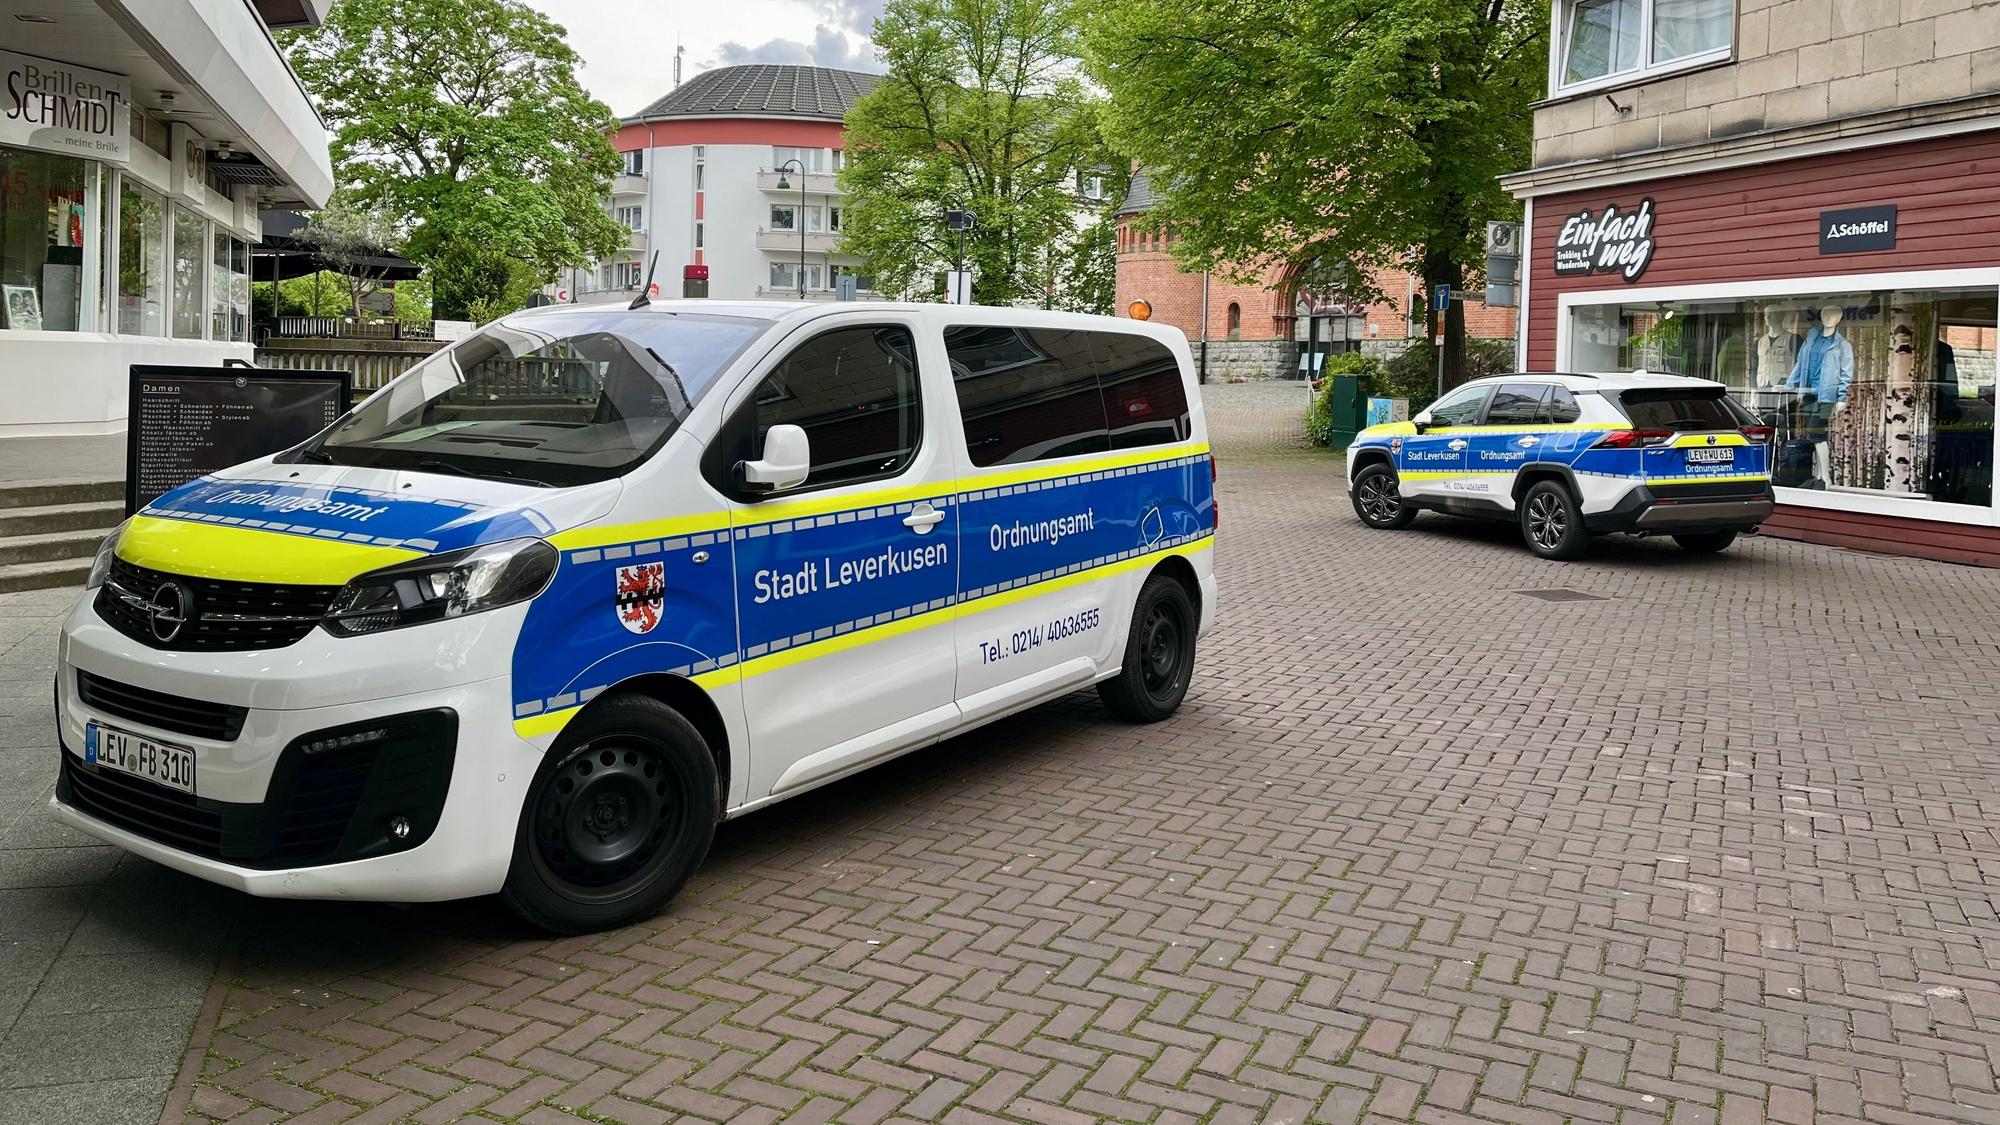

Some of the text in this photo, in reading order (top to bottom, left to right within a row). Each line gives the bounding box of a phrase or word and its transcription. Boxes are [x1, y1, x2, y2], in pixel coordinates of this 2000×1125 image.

[24, 64, 101, 101] Brillen
[7, 70, 120, 136] SCHMIDT
[65, 138, 93, 149] meine
[95, 141, 120, 153] Brille
[1558, 201, 1651, 256] Einfach
[1840, 221, 1889, 236] Schöffel
[1598, 240, 1651, 277] weg
[142, 384, 180, 392] Damen
[1408, 450, 1460, 461] Stadt Leverkusen
[1480, 450, 1526, 462] Ordnungsamt
[1685, 464, 1734, 474] Ordnungsamt
[1690, 448, 1734, 461] LEV WU 613
[205, 489, 389, 522] Ordnungsamt
[990, 507, 1095, 552] Ordnungsamt
[754, 542, 948, 605] Stadt Leverkusen
[979, 608, 1100, 665] Tel.: 0214/ 40636555
[97, 730, 190, 787] LEV FB 310
